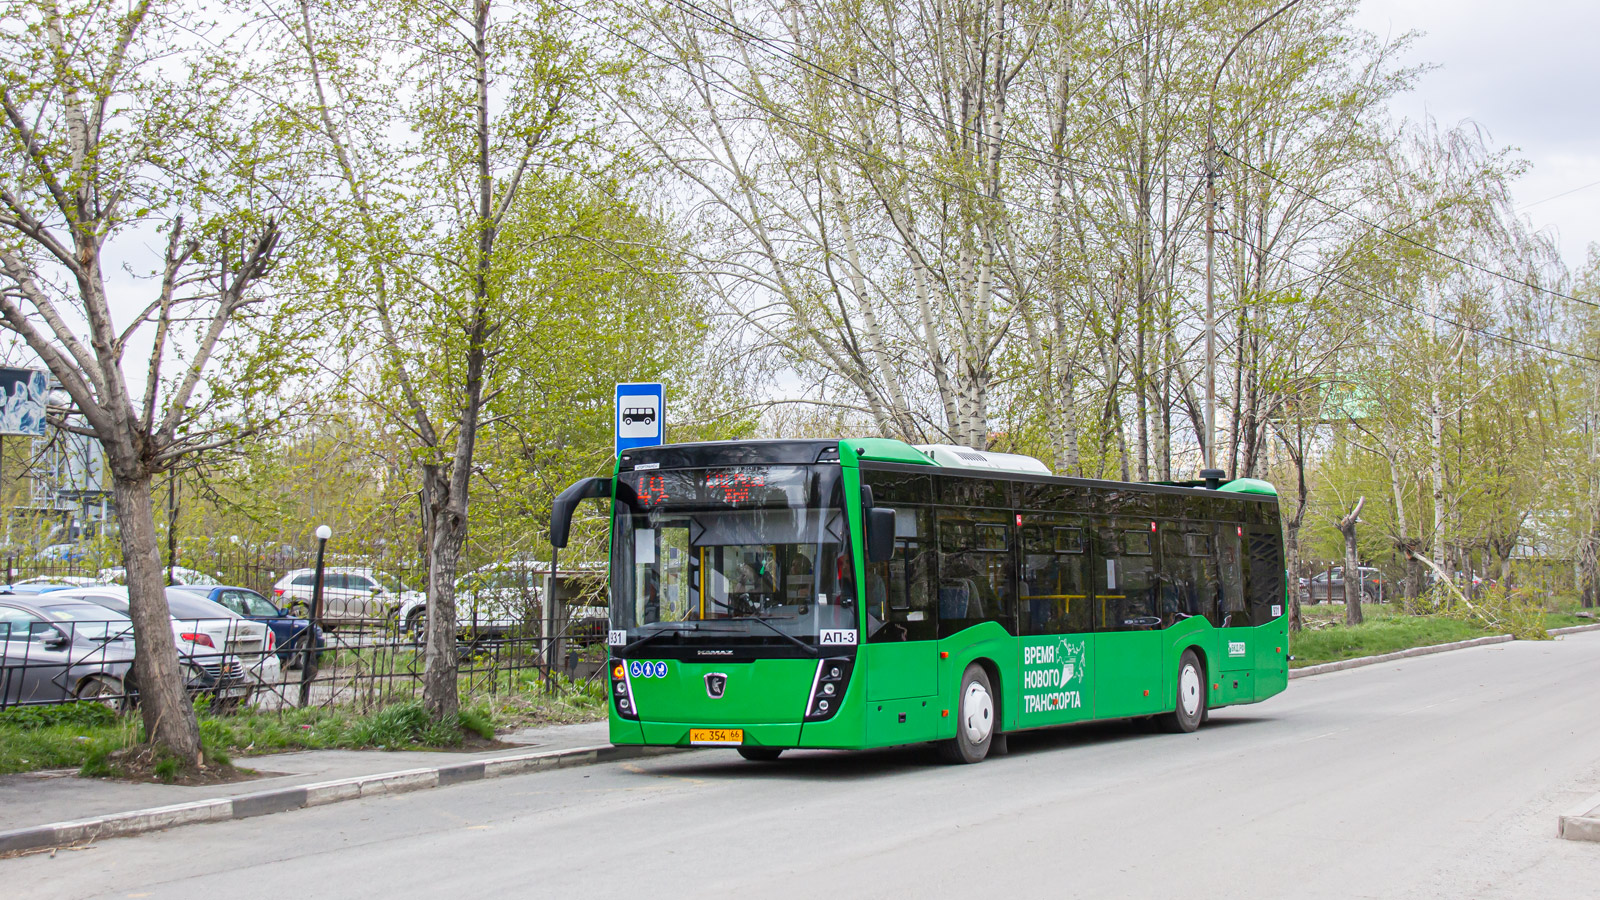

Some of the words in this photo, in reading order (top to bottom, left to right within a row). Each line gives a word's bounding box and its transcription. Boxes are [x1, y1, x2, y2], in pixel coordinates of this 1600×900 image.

[823, 632, 854, 643] АП-3
[1024, 645, 1054, 665] ВРЕМЯ
[1024, 669, 1060, 689] НОВОГО
[1024, 691, 1081, 713] ТРАНСПОРТА
[709, 731, 726, 741] 354
[730, 730, 740, 738] 66
